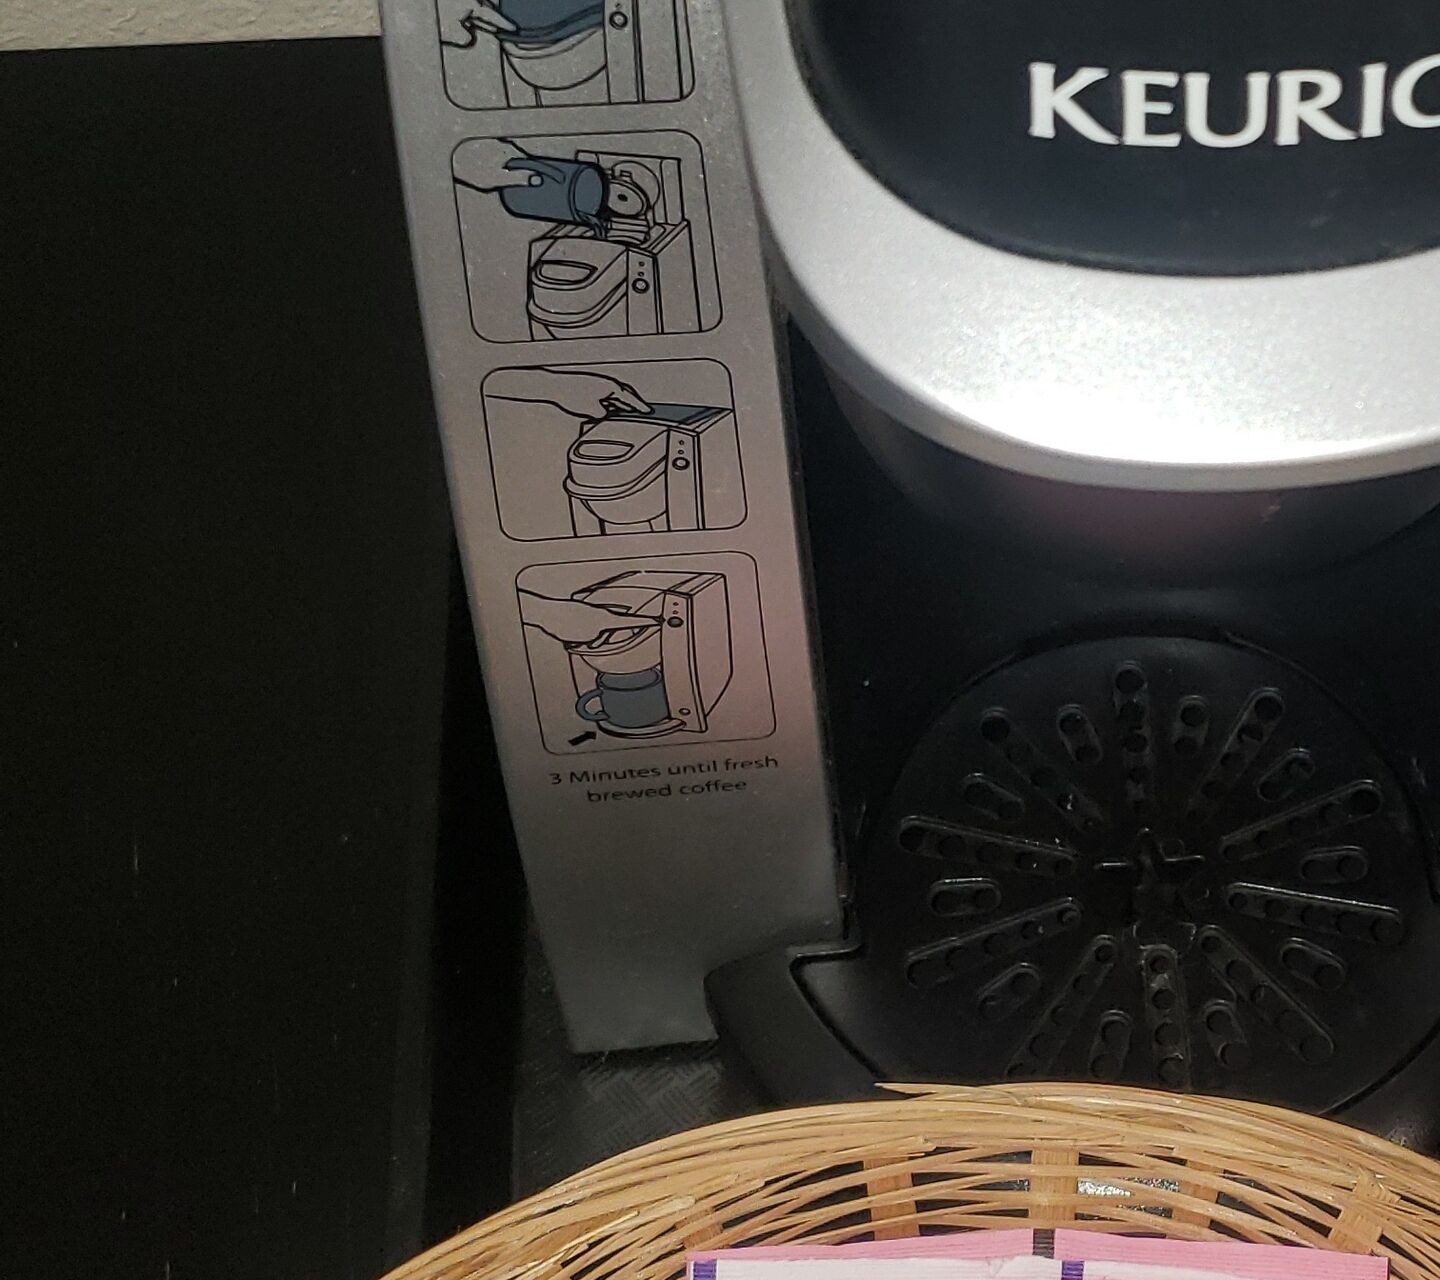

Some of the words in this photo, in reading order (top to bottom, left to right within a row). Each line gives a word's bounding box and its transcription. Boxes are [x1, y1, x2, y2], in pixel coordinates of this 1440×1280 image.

[550, 772, 562, 785] 3
[569, 766, 662, 785] Minutes
[667, 760, 718, 776] until
[724, 755, 779, 772] fresh
[587, 784, 673, 803] brewed
[680, 779, 748, 796] coffee
